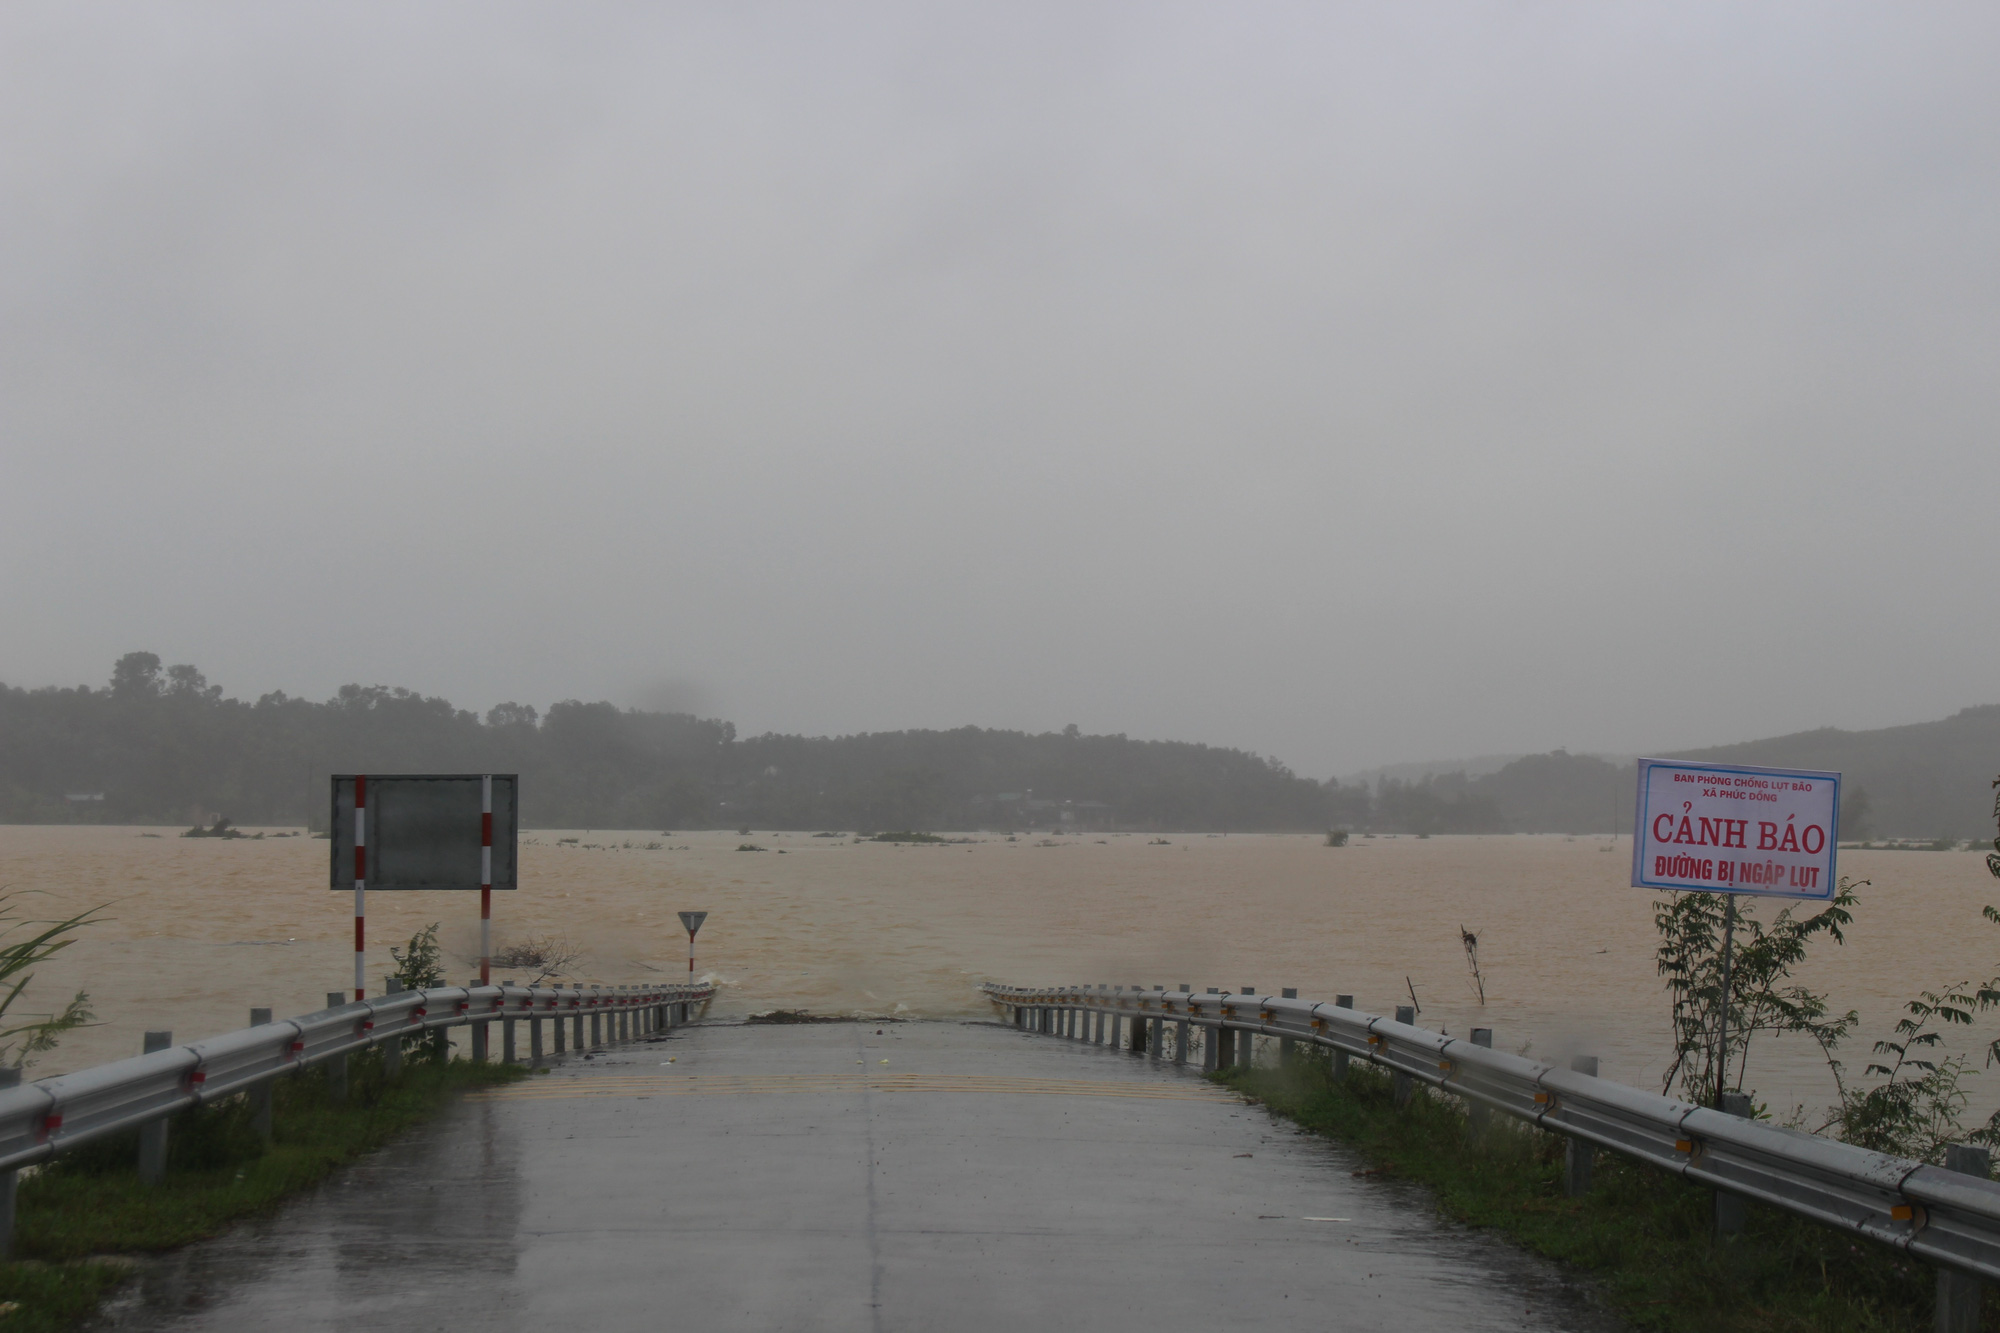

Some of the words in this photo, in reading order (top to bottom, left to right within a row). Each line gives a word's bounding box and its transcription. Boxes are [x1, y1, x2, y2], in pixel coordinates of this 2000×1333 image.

[1674, 774, 1695, 783] BAN
[1697, 775, 1731, 786] PHÒNG
[1771, 780, 1789, 792] LỤT
[1792, 780, 1812, 792] BÃO
[1703, 787, 1716, 798] XÃ
[1719, 788, 1746, 800] PHÚC
[1653, 801, 1748, 848] CẢNH
[1756, 813, 1825, 854] BÁO
[1655, 852, 1712, 879] ĐƯỜNG
[1718, 861, 1735, 886] BỊ
[1740, 860, 1785, 889] NGẬP
[1790, 866, 1819, 892] LỤT
